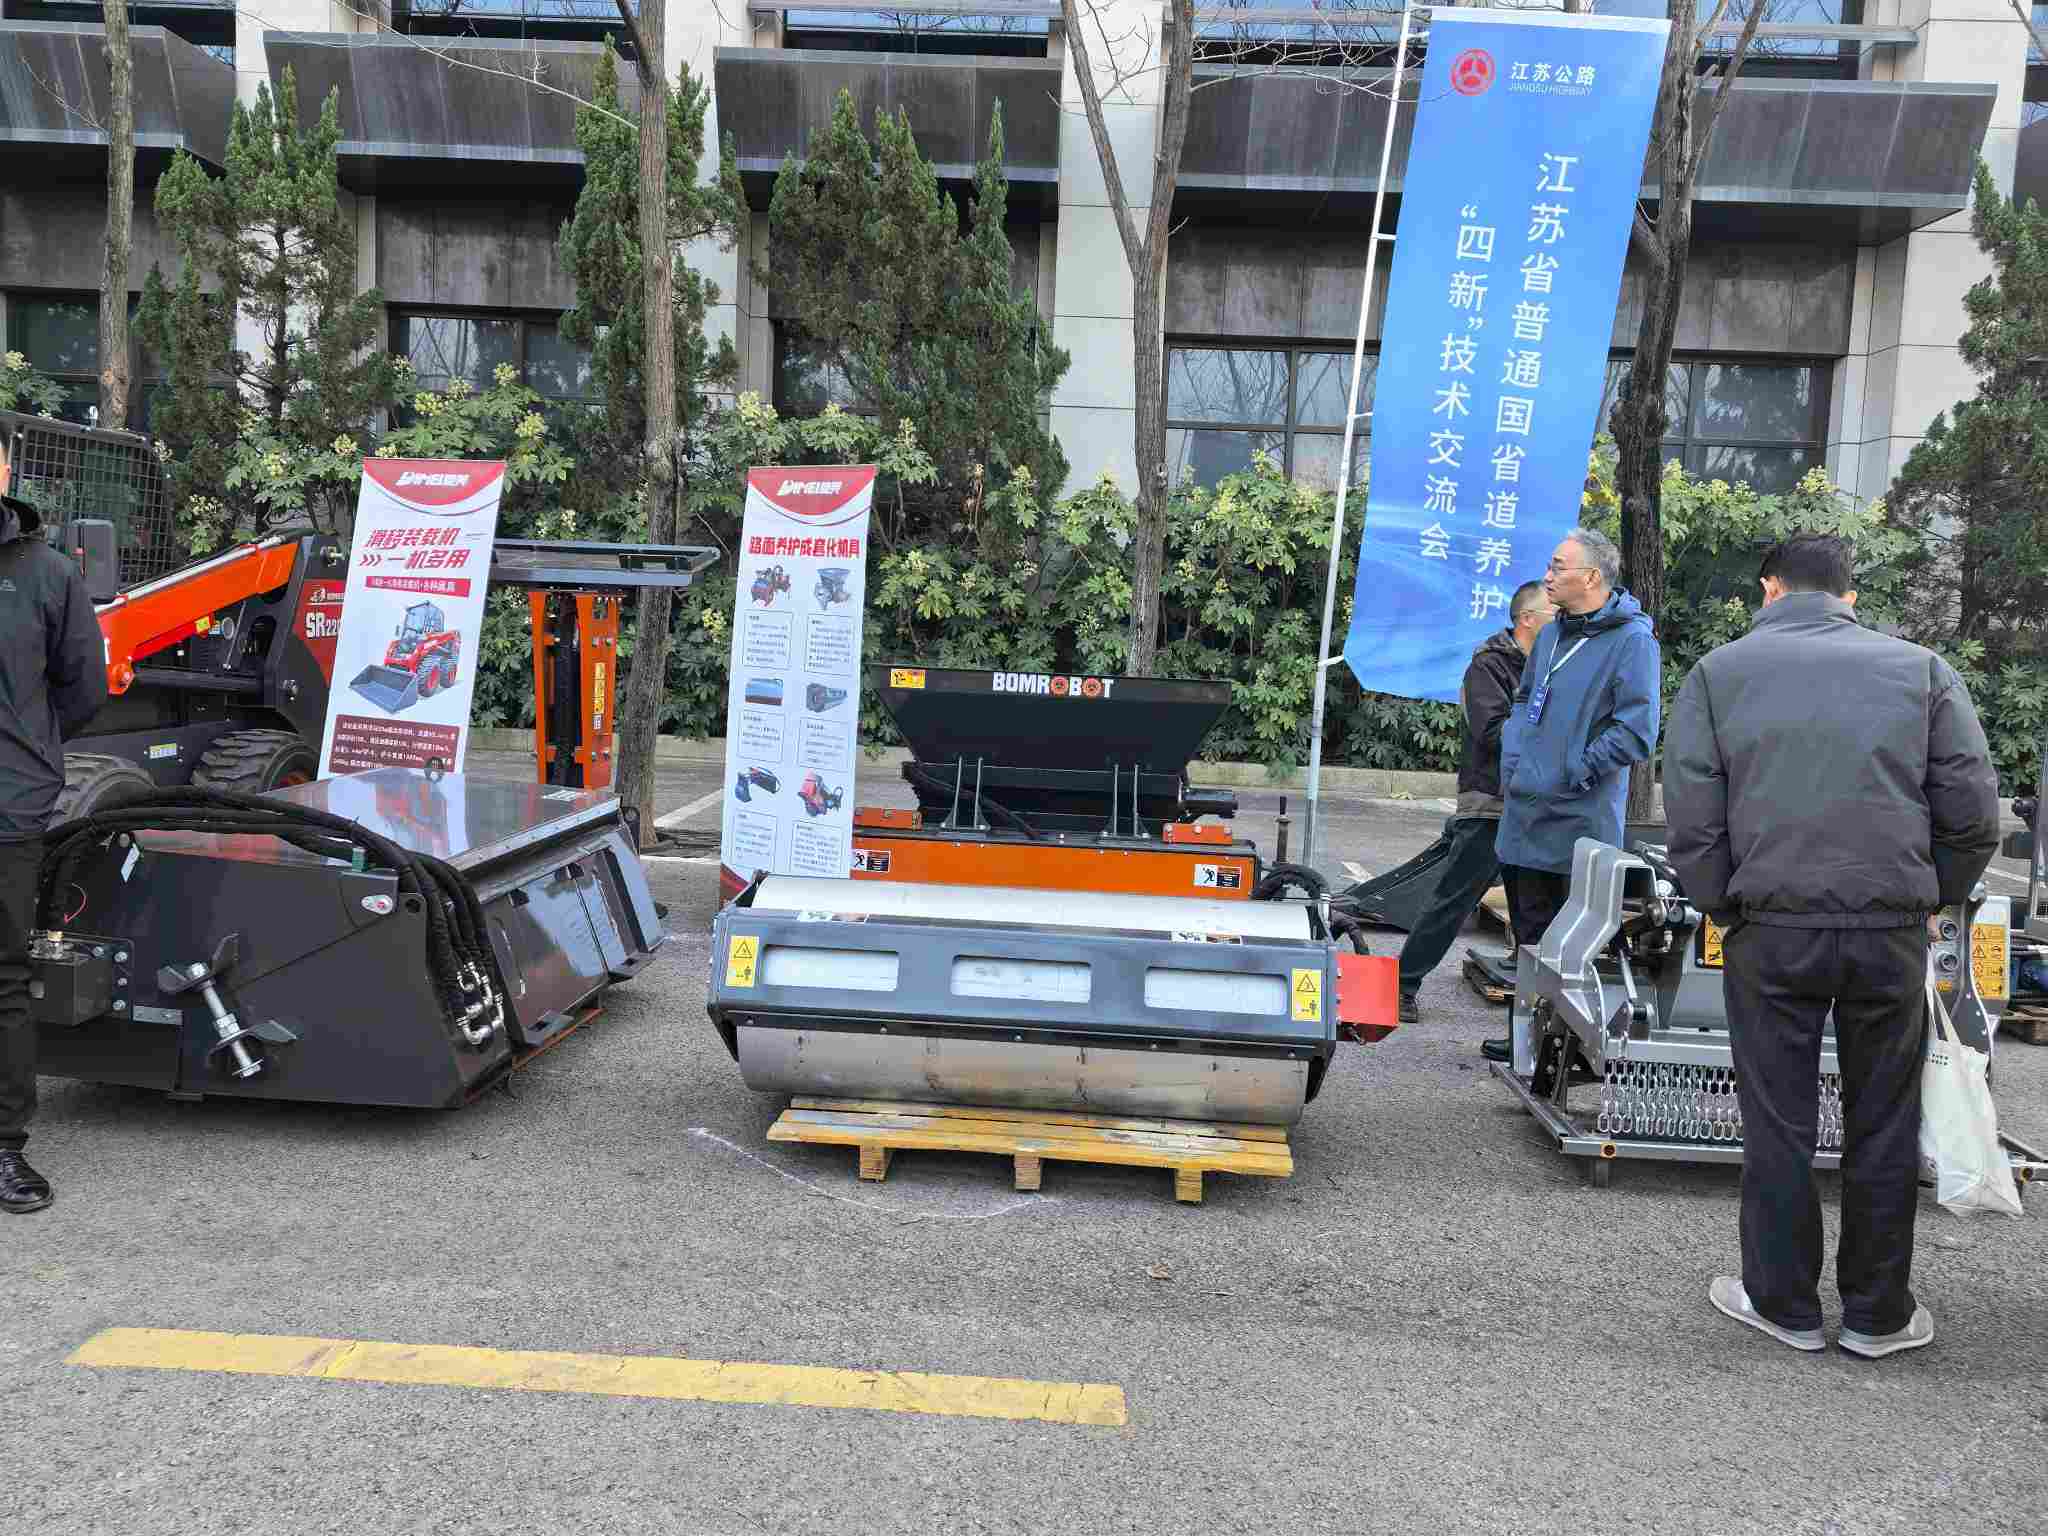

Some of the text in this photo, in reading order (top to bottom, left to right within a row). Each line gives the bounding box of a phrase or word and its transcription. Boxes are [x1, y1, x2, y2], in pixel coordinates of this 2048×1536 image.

[1511, 61, 1596, 86] 江苏公路
[1470, 152, 1579, 620] 江苏省普通国省道养护
[992, 671, 1114, 698] BOMROBOT
